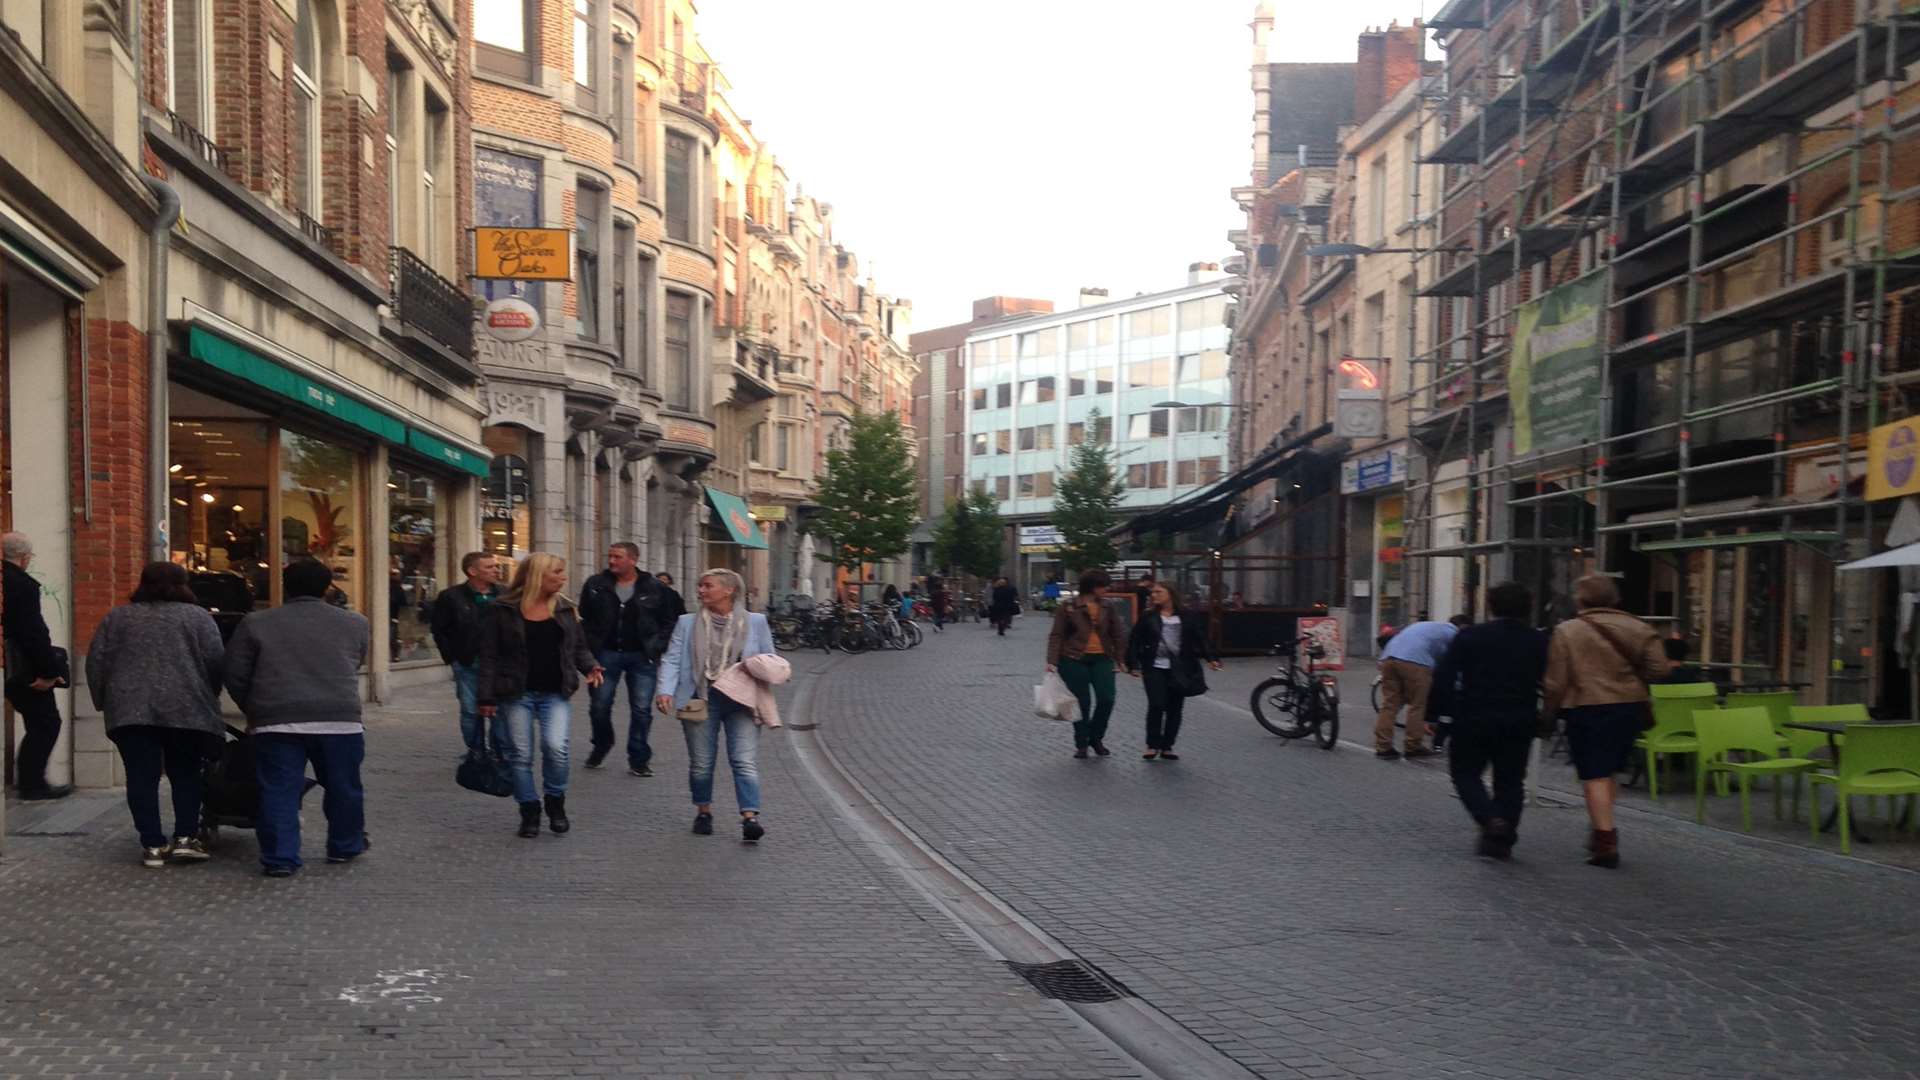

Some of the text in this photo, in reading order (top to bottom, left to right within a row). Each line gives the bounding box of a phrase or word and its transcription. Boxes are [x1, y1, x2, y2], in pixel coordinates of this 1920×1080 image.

[489, 230, 555, 256] The Seven
[498, 252, 547, 277] Oaks
[477, 337, 543, 365] ANNO
